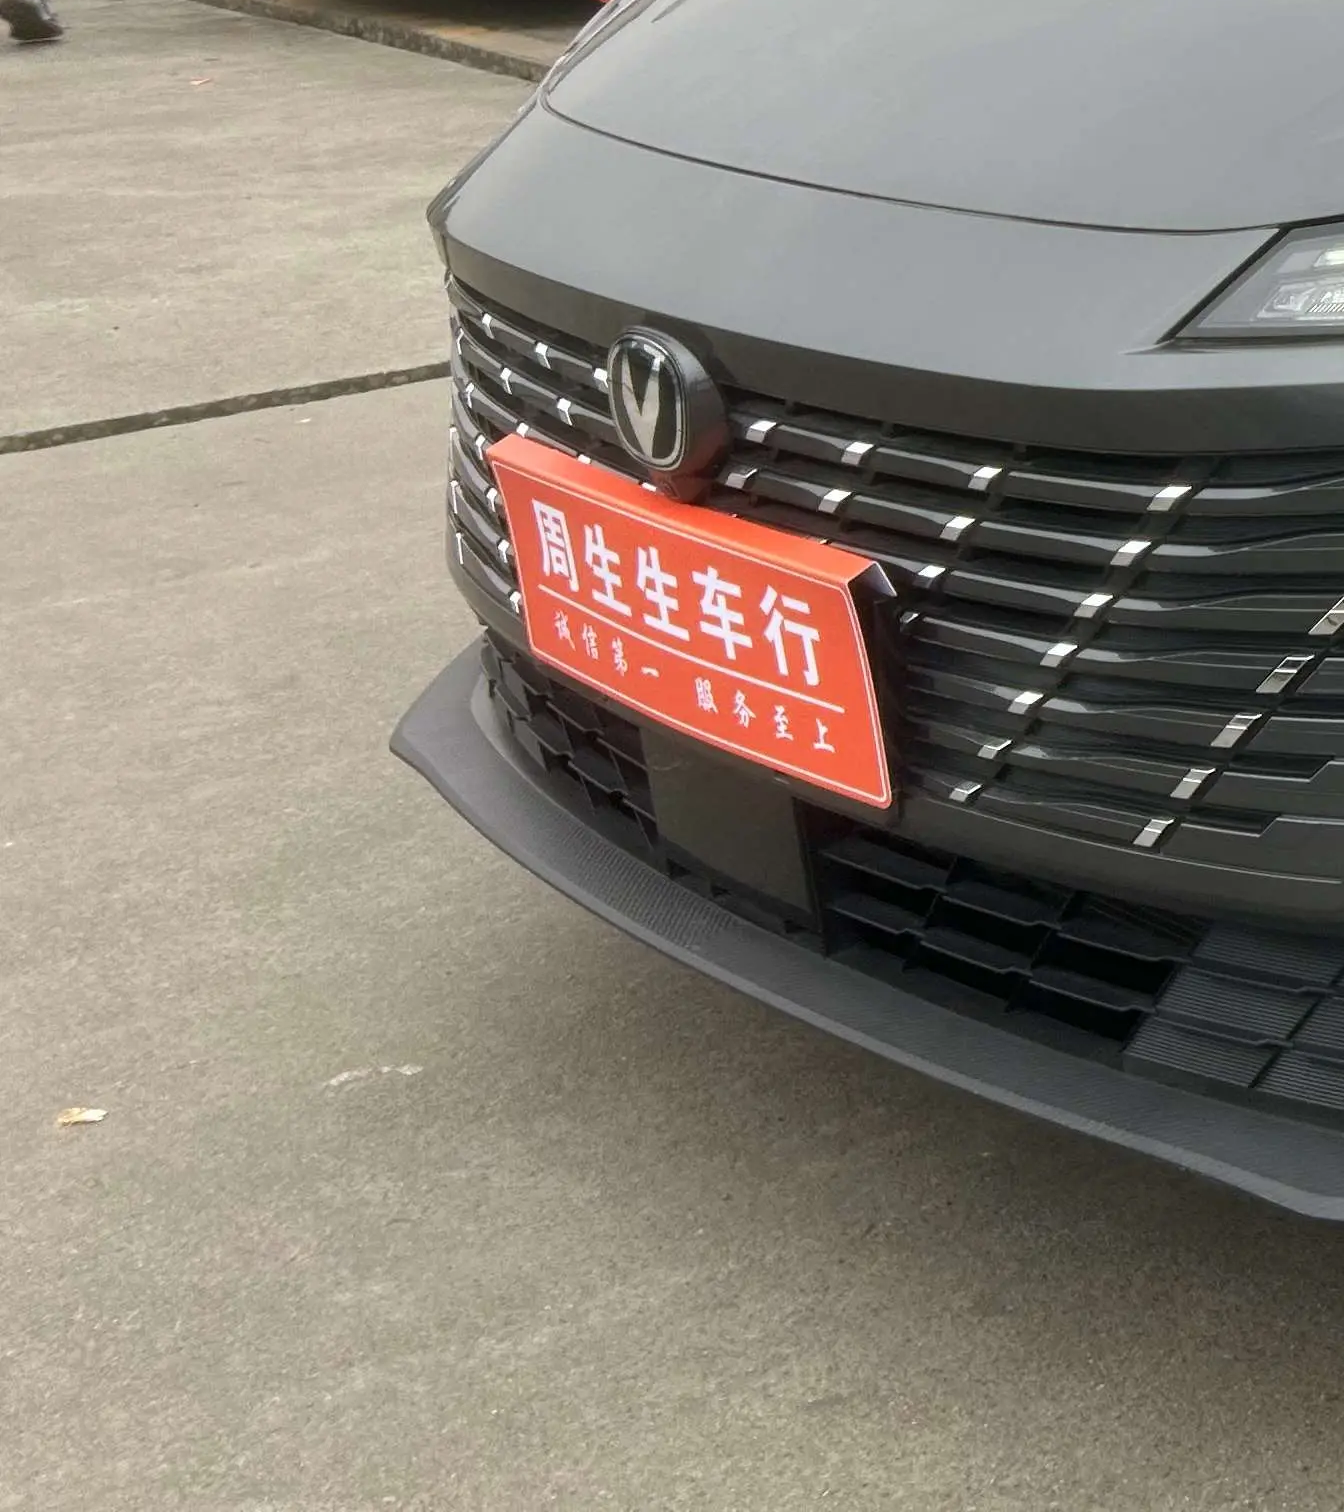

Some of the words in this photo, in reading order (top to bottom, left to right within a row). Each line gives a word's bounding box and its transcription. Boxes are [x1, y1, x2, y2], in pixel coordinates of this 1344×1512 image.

[531, 497, 821, 686] 周生生车行
[553, 609, 660, 678] 诚信第一
[694, 676, 836, 754] 服务至上
